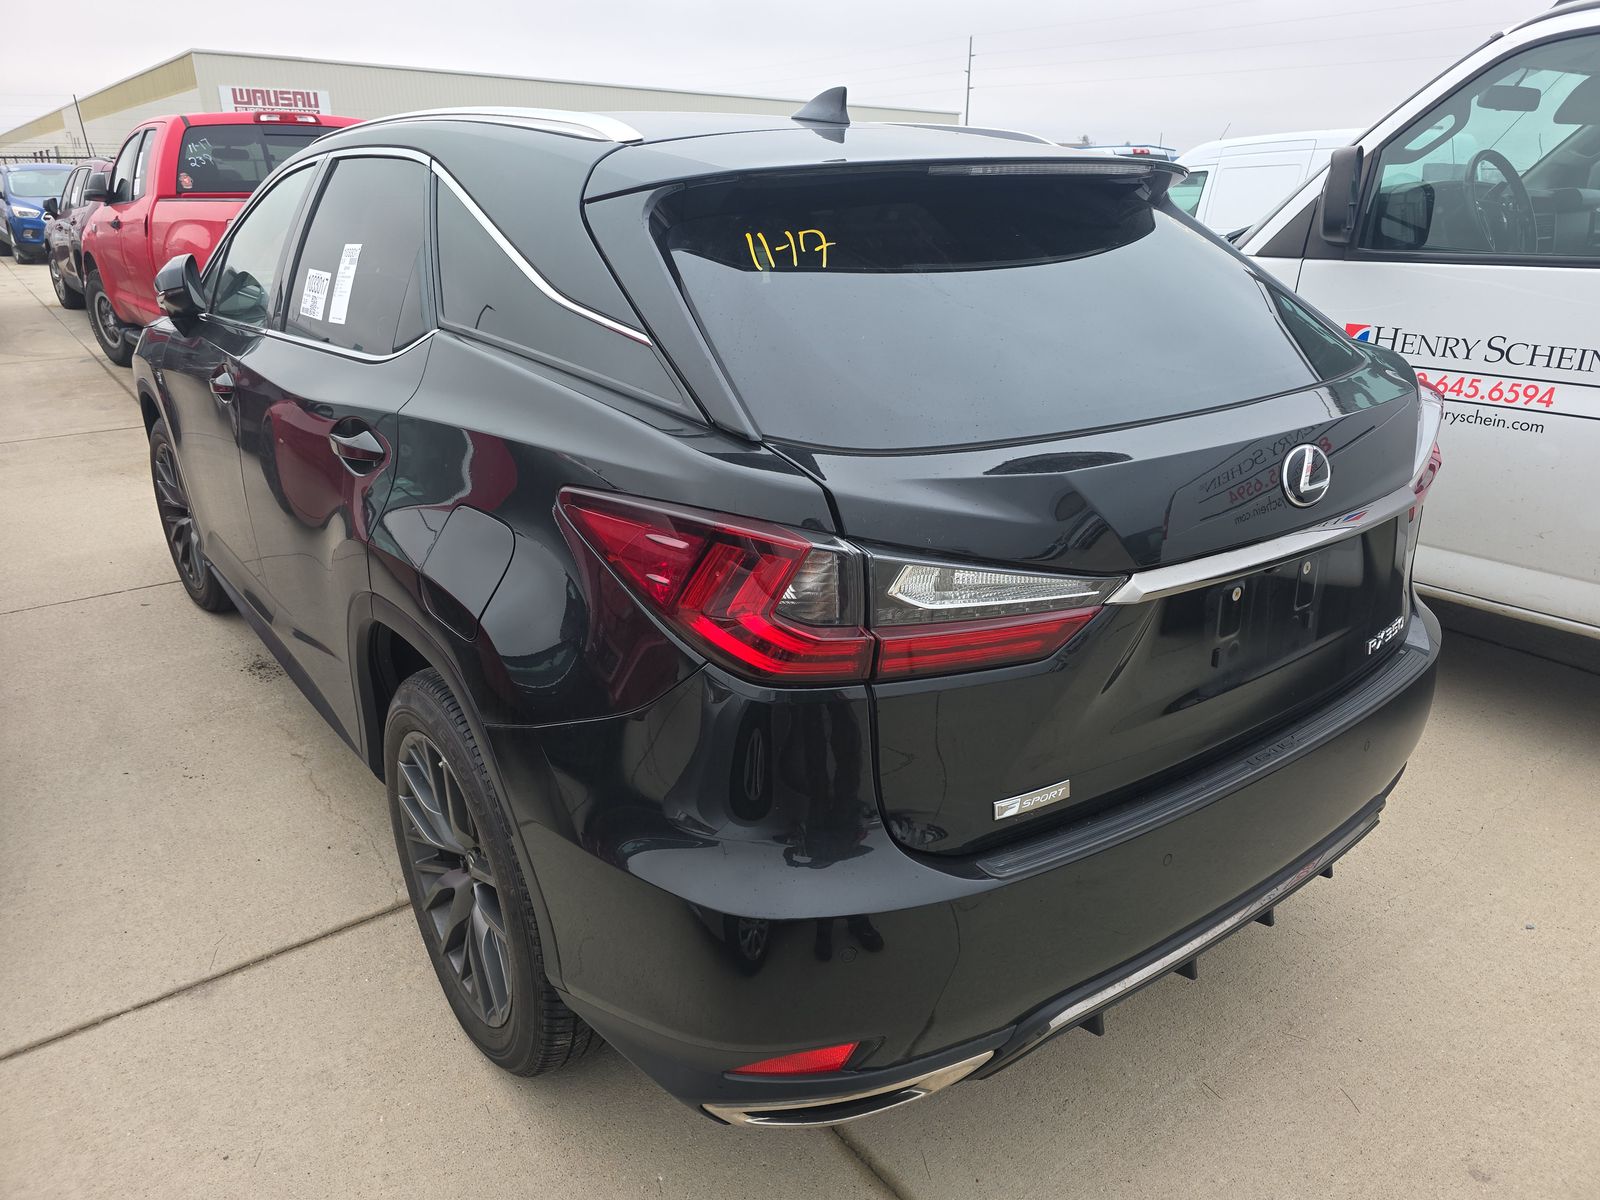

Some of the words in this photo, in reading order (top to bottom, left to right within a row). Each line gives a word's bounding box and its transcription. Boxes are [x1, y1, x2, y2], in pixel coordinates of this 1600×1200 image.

[231, 87, 320, 109] WAUSAU
[188, 138, 213, 153] 11-17
[745, 229, 836, 271] 11-17
[1374, 325, 1481, 361] HENRY
[1484, 335, 1600, 373] SCHEIN
[1417, 372, 1556, 408] 645.6594
[1443, 409, 1545, 434] ryschein.com
[1021, 786, 1067, 809] SPORT
